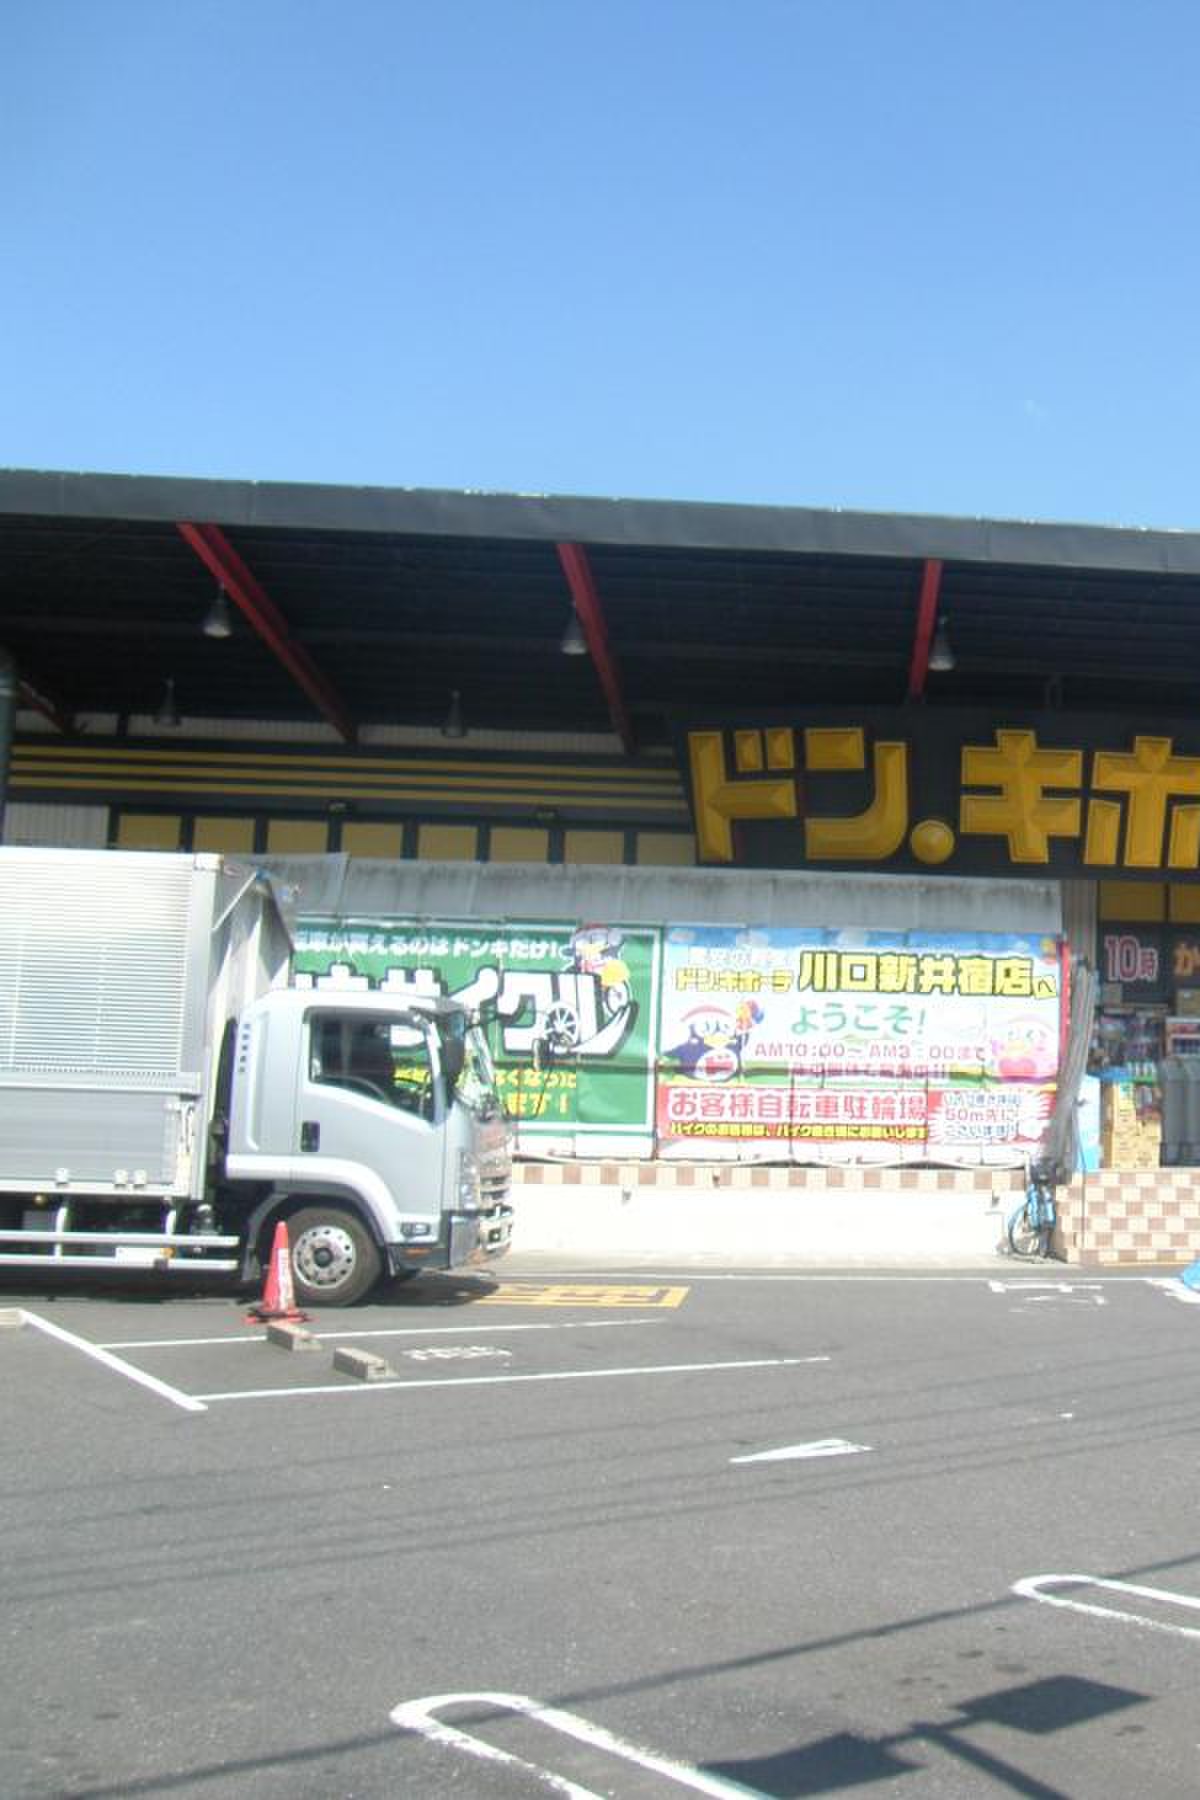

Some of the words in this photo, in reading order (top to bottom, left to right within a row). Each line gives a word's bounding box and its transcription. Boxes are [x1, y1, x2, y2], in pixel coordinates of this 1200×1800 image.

[789, 1002, 928, 1035] ようこそ!
[670, 1091, 927, 1121] お客様自転車駐輪場
